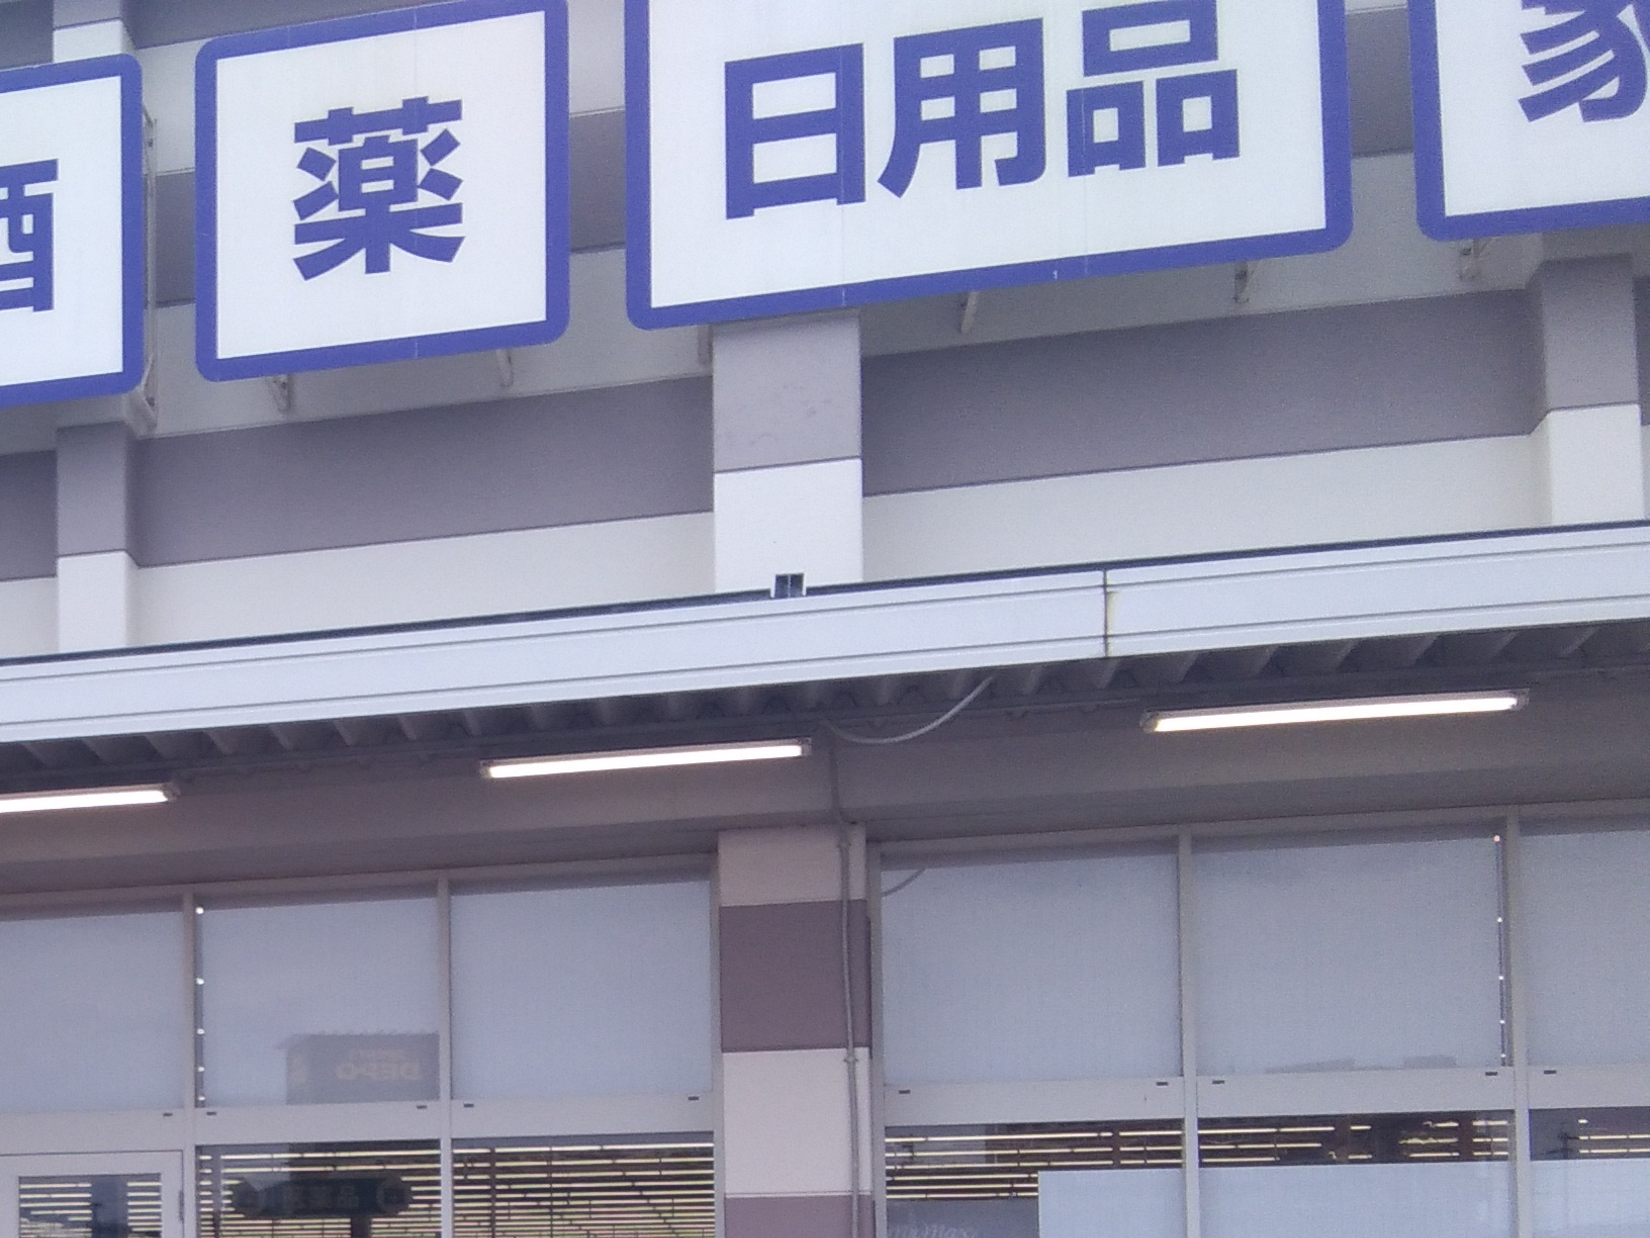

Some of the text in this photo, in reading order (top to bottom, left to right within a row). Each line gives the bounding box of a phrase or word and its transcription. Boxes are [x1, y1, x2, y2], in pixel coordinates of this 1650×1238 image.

[293, 97, 464, 281] 薬
[724, 0, 1240, 220] 日用品
